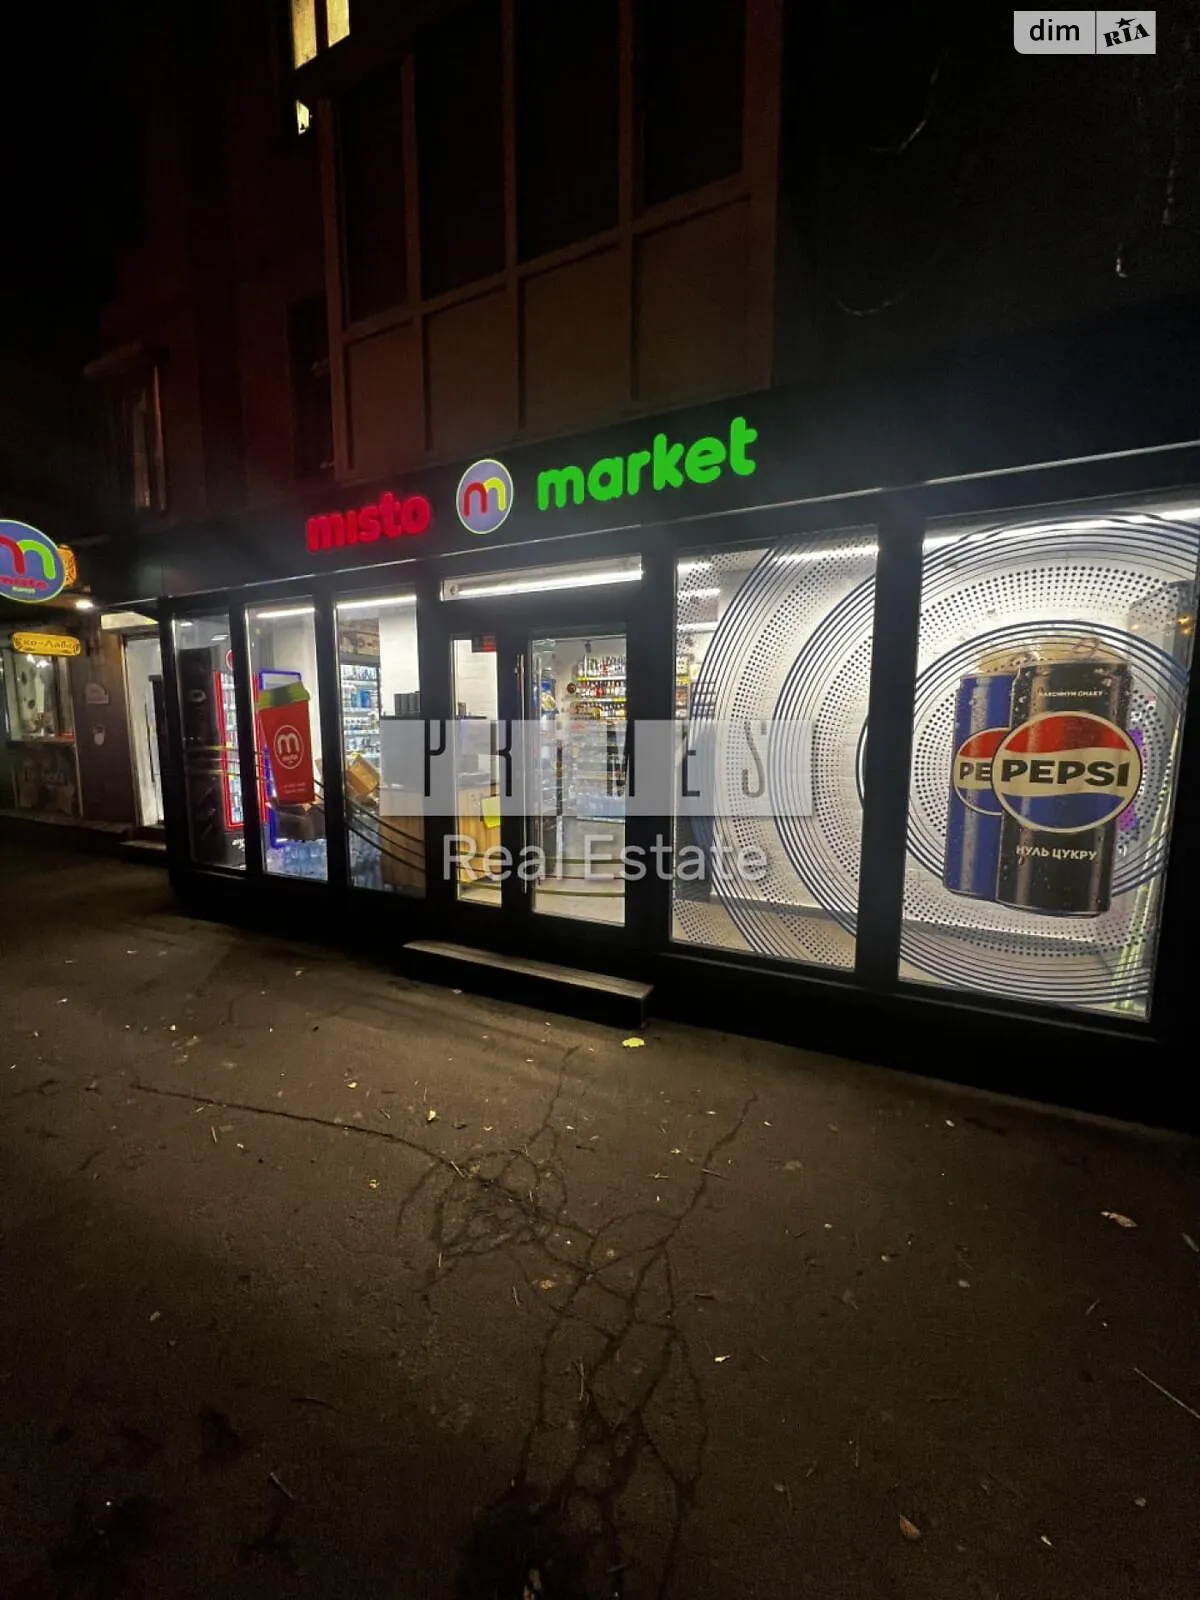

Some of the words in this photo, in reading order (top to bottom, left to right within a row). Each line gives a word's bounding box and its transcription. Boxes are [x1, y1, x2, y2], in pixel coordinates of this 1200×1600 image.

[306, 492, 432, 553] misto
[537, 416, 759, 511] market
[1001, 759, 1130, 787] PEPSI
[1016, 845, 1049, 857] НУЛЬ
[1052, 848, 1098, 861] ЦУКРУ
